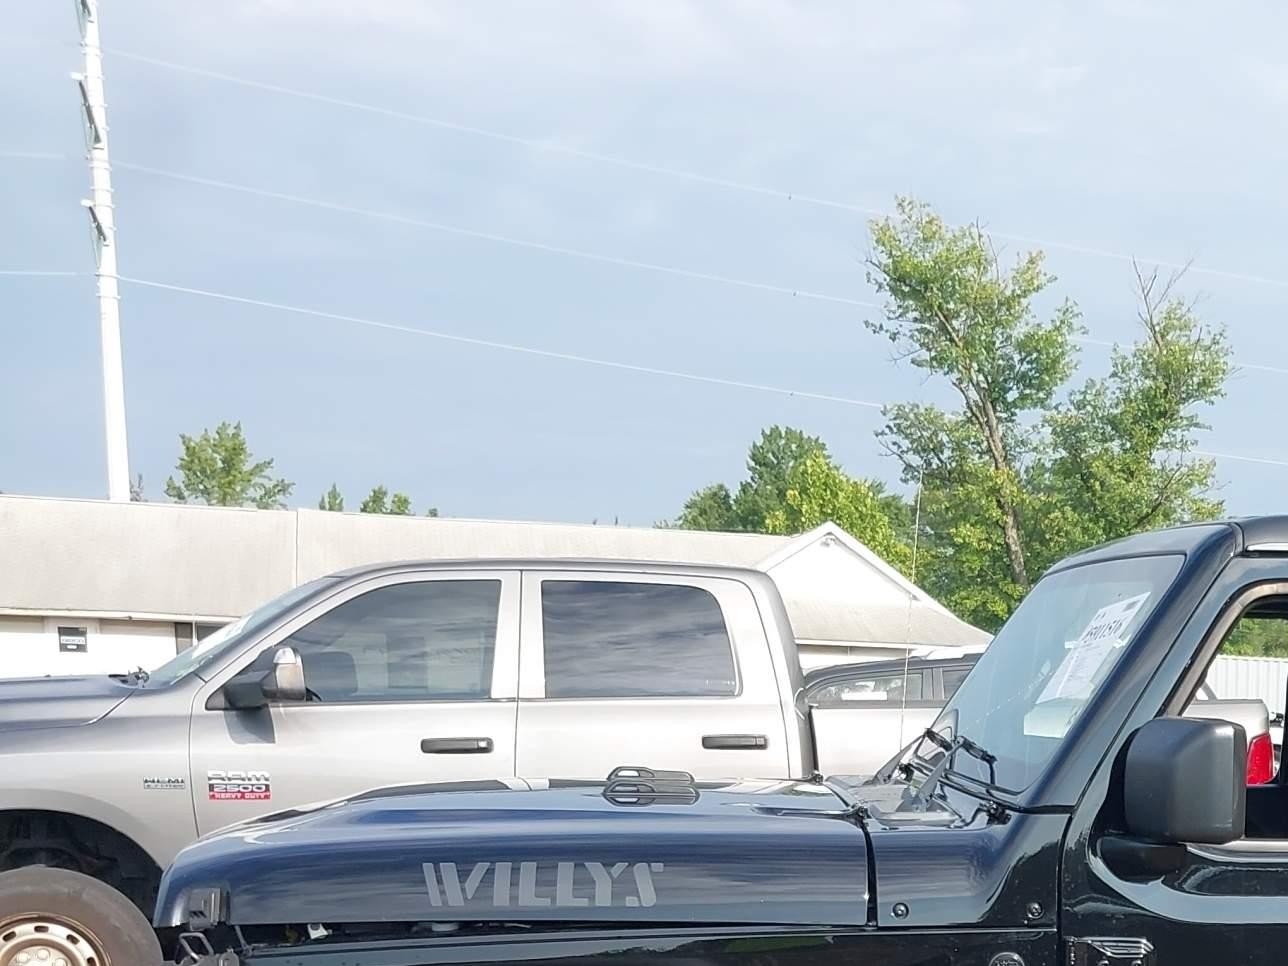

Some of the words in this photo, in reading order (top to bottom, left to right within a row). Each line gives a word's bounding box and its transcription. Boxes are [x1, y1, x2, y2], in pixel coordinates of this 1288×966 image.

[207, 771, 270, 784] RAM
[213, 784, 266, 792] 2500
[422, 861, 665, 908] WILLYS
